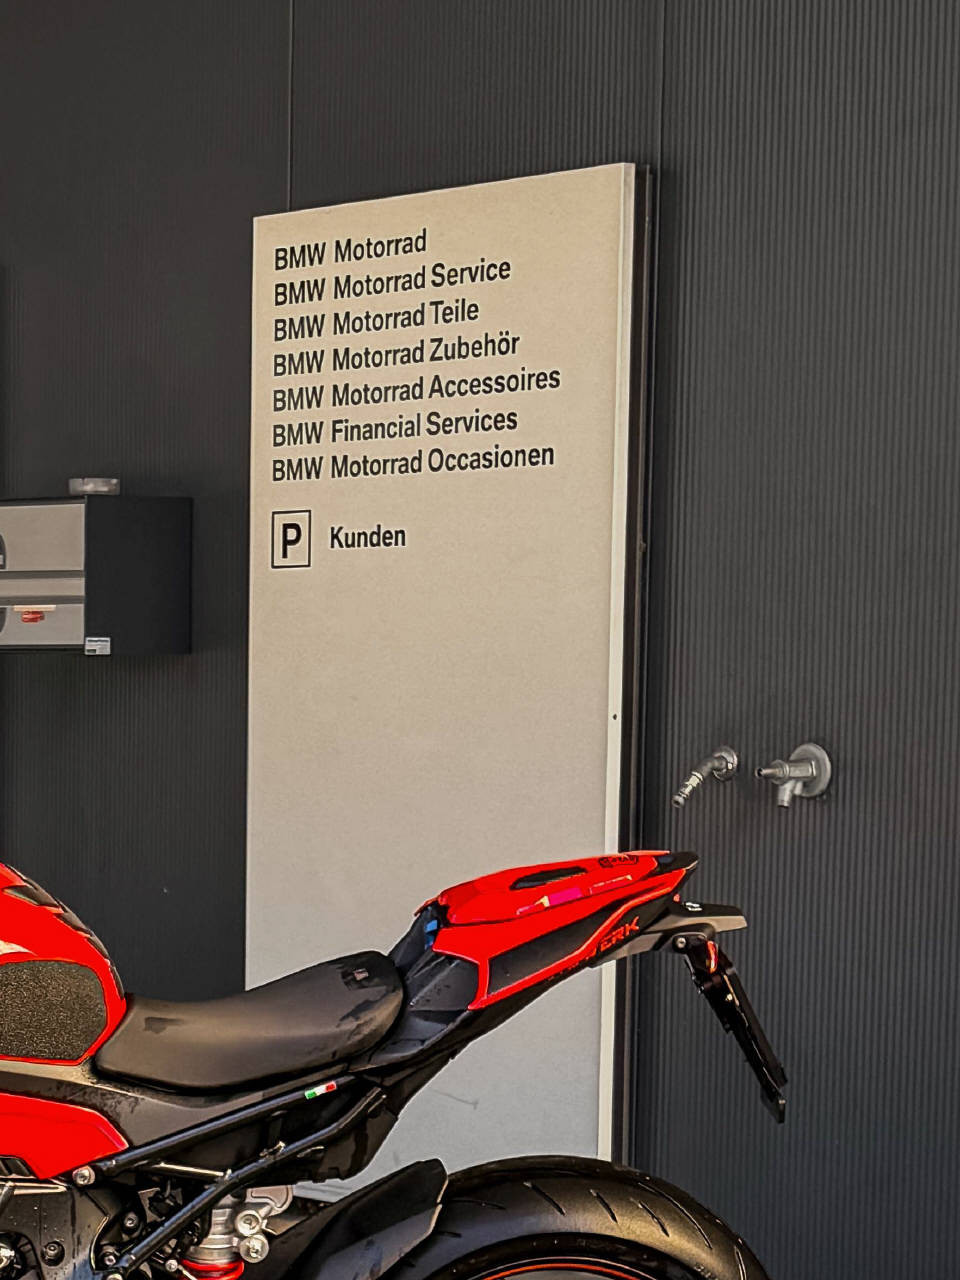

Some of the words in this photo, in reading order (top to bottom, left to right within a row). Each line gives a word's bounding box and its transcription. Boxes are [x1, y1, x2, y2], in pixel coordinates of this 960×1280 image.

[275, 242, 326, 271] BMW
[334, 228, 427, 263] Motorrad
[274, 278, 326, 306] BMW
[333, 265, 427, 299] Motorrad
[431, 257, 511, 289] Service
[274, 314, 326, 342] BMW
[333, 302, 425, 336] Motorrad
[429, 298, 479, 326] Teile
[273, 349, 325, 377] BMW
[332, 340, 424, 372] Motorrad
[429, 330, 520, 362] Zubehör
[273, 385, 325, 412] BMW
[331, 377, 424, 407] Motorrad
[428, 366, 561, 399] Accessoires
[272, 421, 324, 447] BMW
[331, 412, 421, 443] Financial
[426, 407, 518, 436] Services
[272, 456, 323, 481] BMW
[330, 450, 423, 478] Motorrad
[427, 443, 555, 473] Occasionen
[281, 522, 303, 559] P
[329, 524, 406, 549] Kunden
